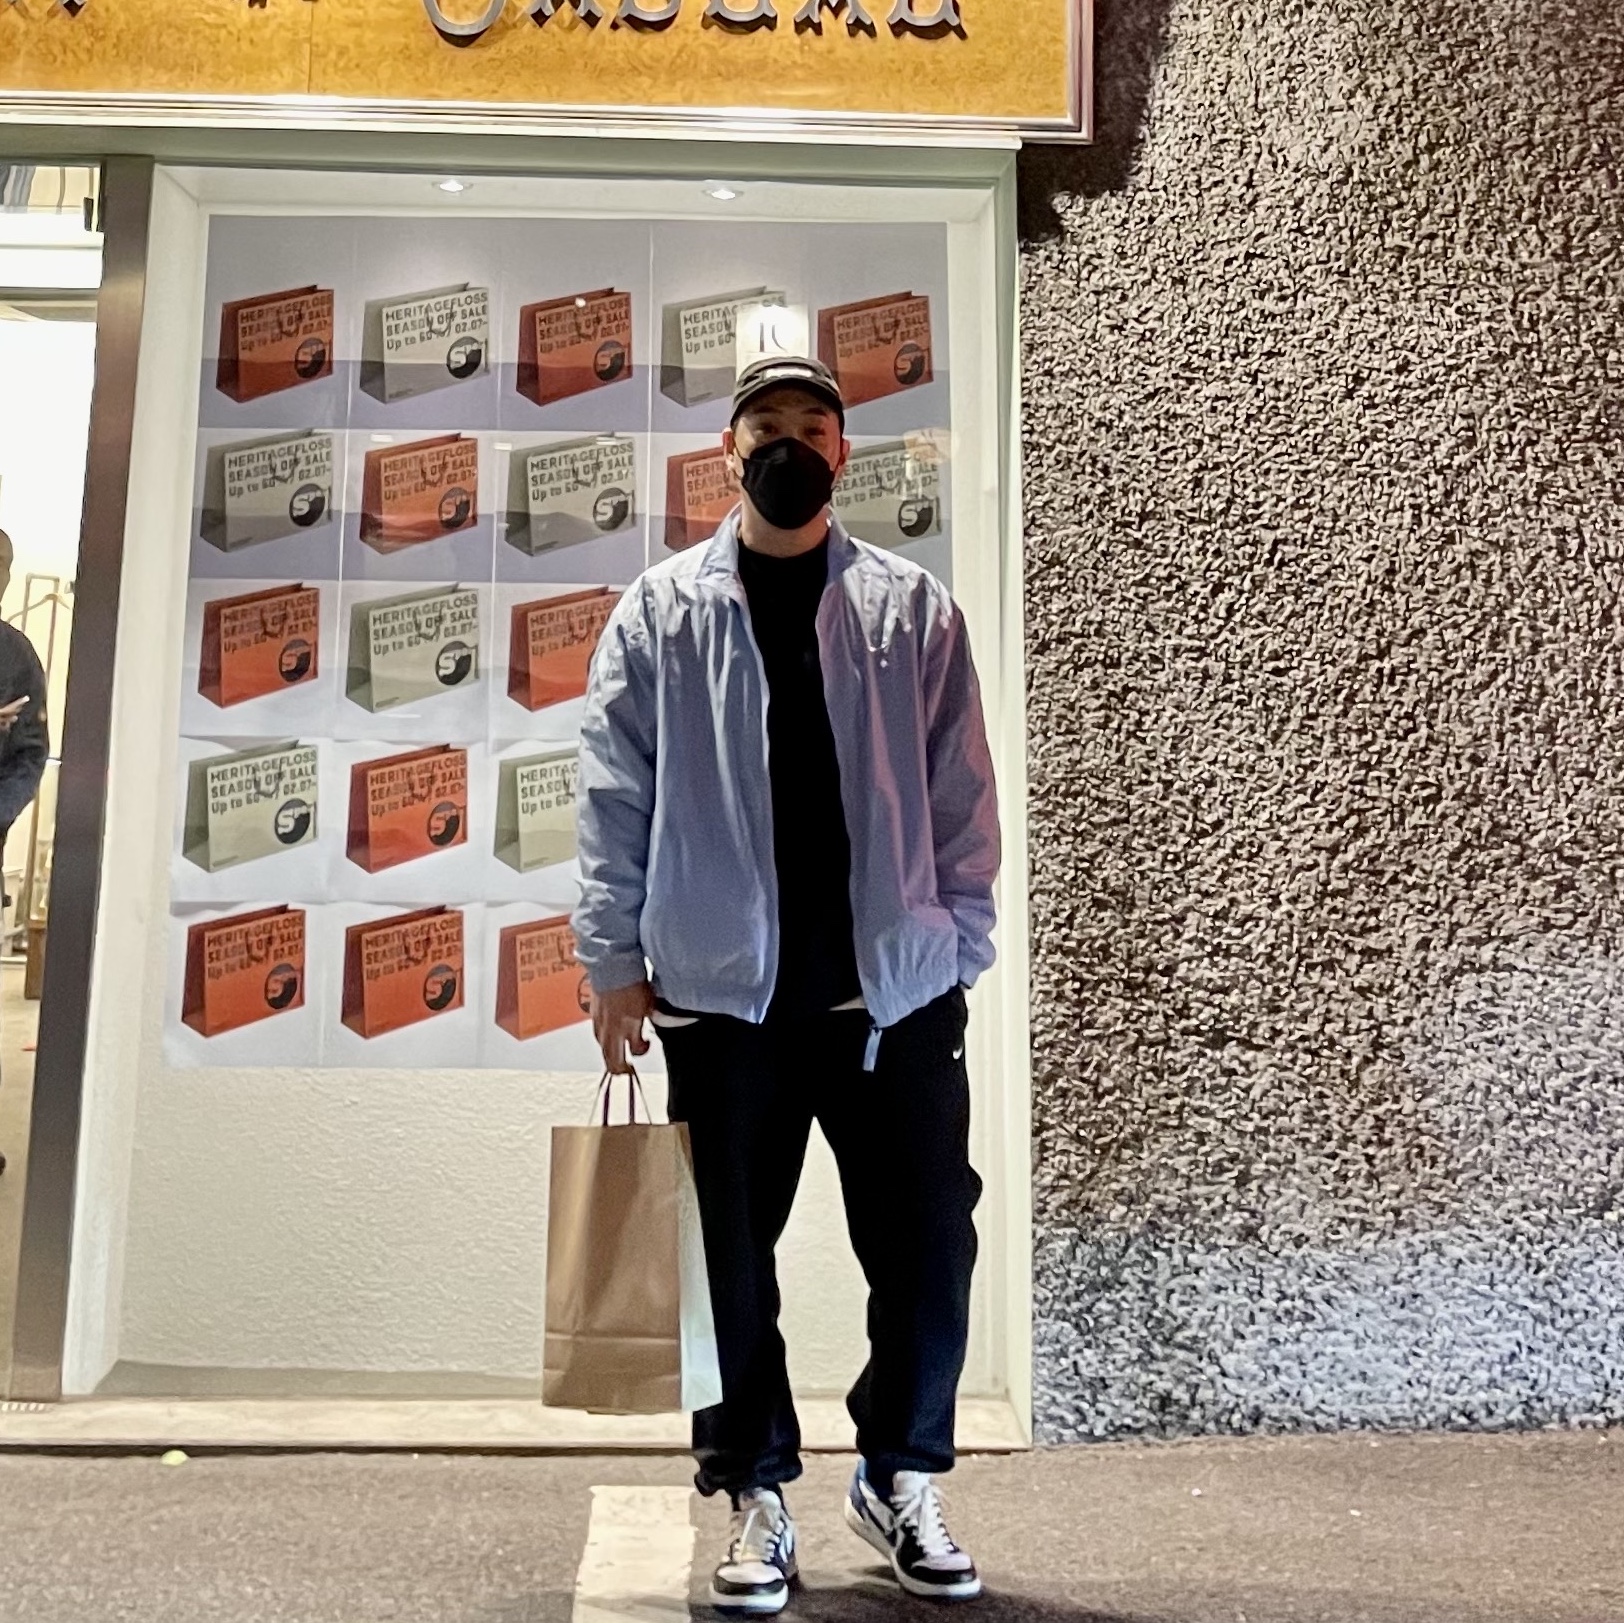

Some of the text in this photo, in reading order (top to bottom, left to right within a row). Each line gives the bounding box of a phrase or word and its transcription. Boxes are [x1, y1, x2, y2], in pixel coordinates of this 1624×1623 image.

[386, 293, 488, 322] HERITAGEFLOSS
[461, 304, 487, 320] SALE
[387, 339, 401, 352] Up
[405, 335, 416, 345] to
[685, 342, 700, 355] Up
[703, 340, 715, 349] to
[228, 437, 330, 468] HERITAGEFLOSS
[305, 451, 330, 466] SALE
[531, 441, 633, 472] HERITAGEFLOSS
[607, 454, 633, 471] SALE
[229, 486, 244, 498] Up
[247, 483, 258, 492] to
[532, 488, 547, 502] Up
[551, 487, 562, 497] to
[836, 495, 851, 509] Up
[855, 493, 866, 503] to
[373, 593, 478, 627] HERITAGEFLOSS
[450, 607, 477, 623] SALE
[374, 643, 389, 656] Up
[392, 640, 404, 651] to
[211, 750, 317, 783] HERITAGEFLOSS
[289, 763, 317, 780] SALE
[520, 762, 578, 784] HERITAG
[211, 802, 228, 815] Up
[231, 798, 242, 808] to
[521, 801, 537, 817] Up
[540, 799, 552, 811] to
